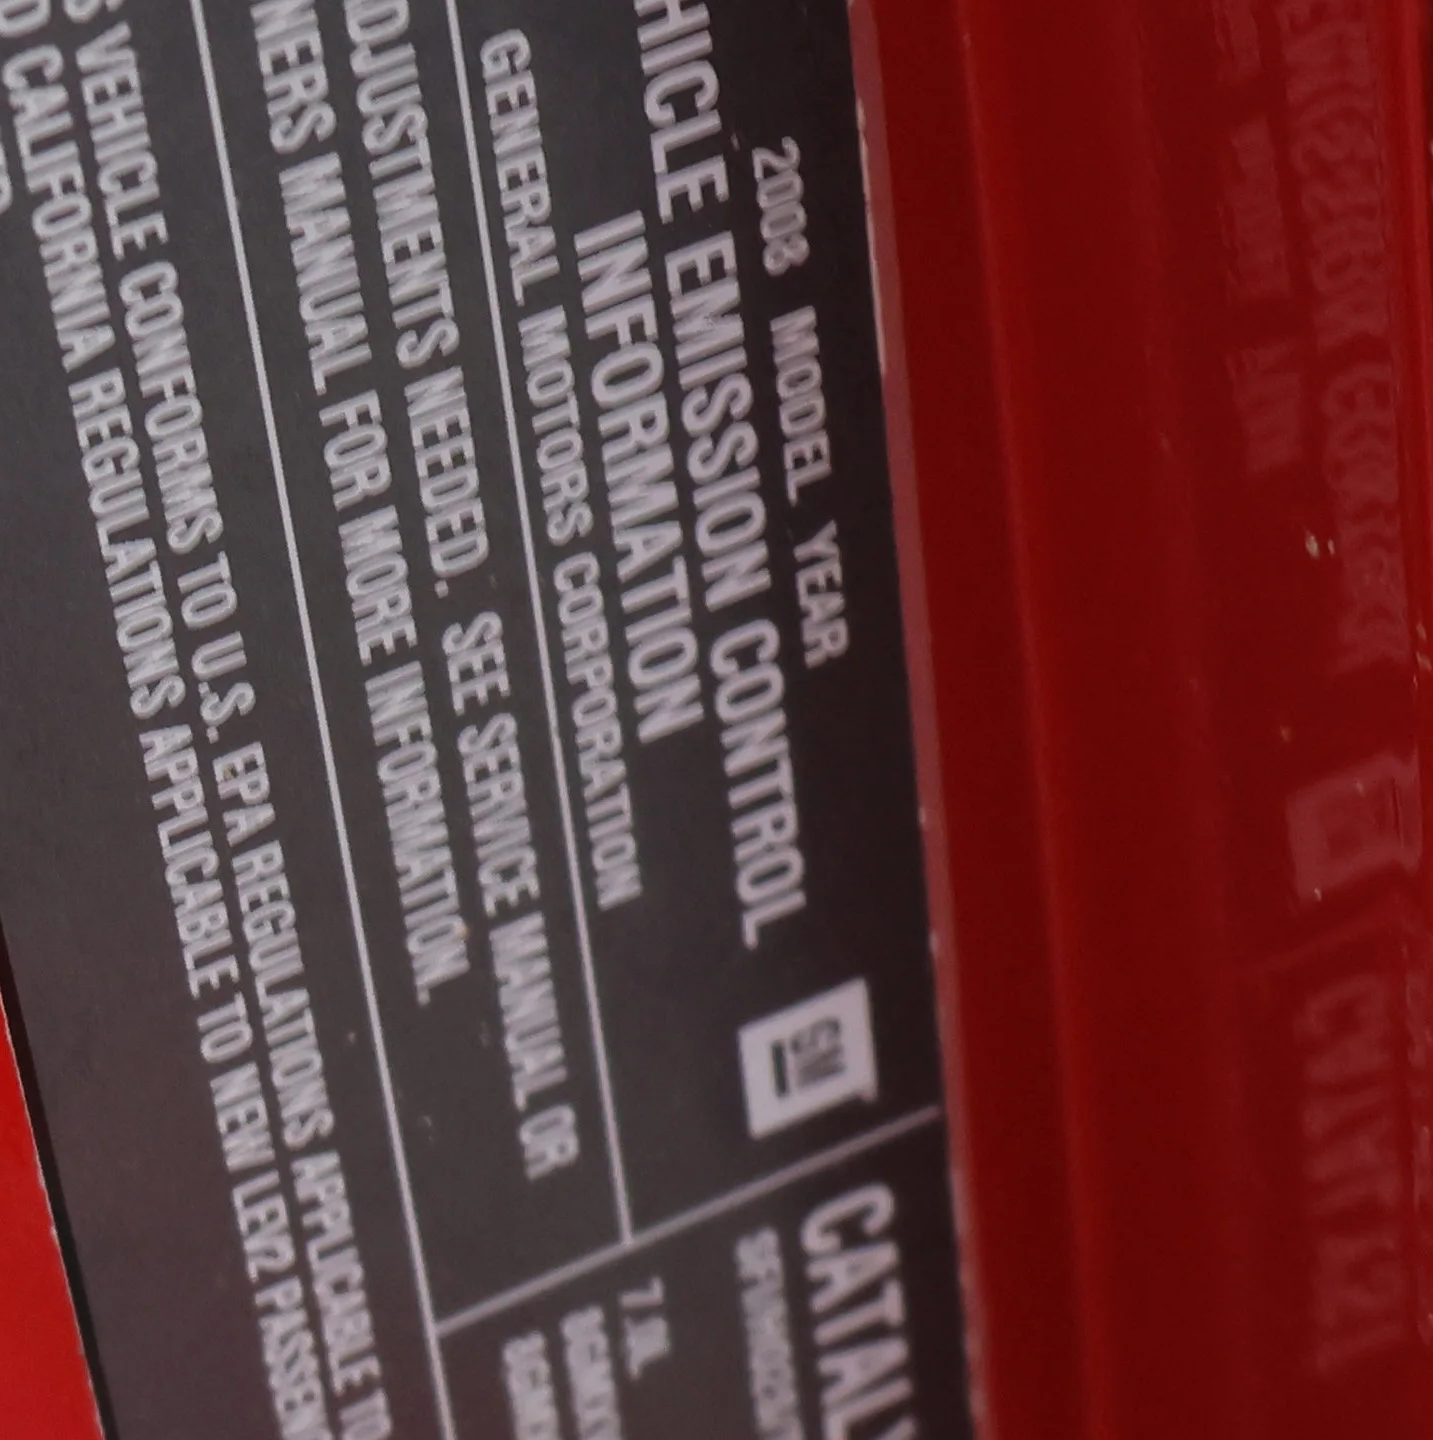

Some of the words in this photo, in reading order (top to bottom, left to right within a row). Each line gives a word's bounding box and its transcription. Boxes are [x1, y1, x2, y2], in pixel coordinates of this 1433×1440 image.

[1, 44, 115, 371] CALIFORNIA
[74, 21, 168, 259] VEHICLE
[479, 29, 560, 305] GENERAL
[278, 151, 372, 395] MANUAL
[118, 260, 223, 553] CONFORMS
[318, 389, 391, 509] FOR
[403, 365, 489, 597] NEEDED.
[517, 304, 593, 545] MOTORS
[573, 210, 704, 742] INFORMATION
[663, 230, 771, 611] EMISSION
[769, 305, 831, 504] MODEL
[67, 367, 186, 718] REGULATIONS
[176, 550, 238, 628] TO
[337, 504, 417, 665] MORE
[792, 520, 849, 667] YEAR
[190, 630, 256, 743] U.S.
[440, 610, 510, 715] SEE
[552, 551, 642, 908] CORPORATION
[138, 723, 240, 998] APPLICABLE
[211, 741, 275, 845] EPA
[364, 660, 469, 1004] INFORMATION.
[456, 712, 540, 916] SERVICE
[708, 618, 805, 949] CONTROL
[195, 991, 253, 1063] TO
[230, 839, 335, 1148] REGULATIONS
[488, 911, 566, 1111] MANUAL
[209, 1061, 275, 1171] NEW
[231, 1170, 296, 1282] LEV2
[517, 1103, 579, 1179] OR
[290, 1150, 381, 1394] APPLICABLE
